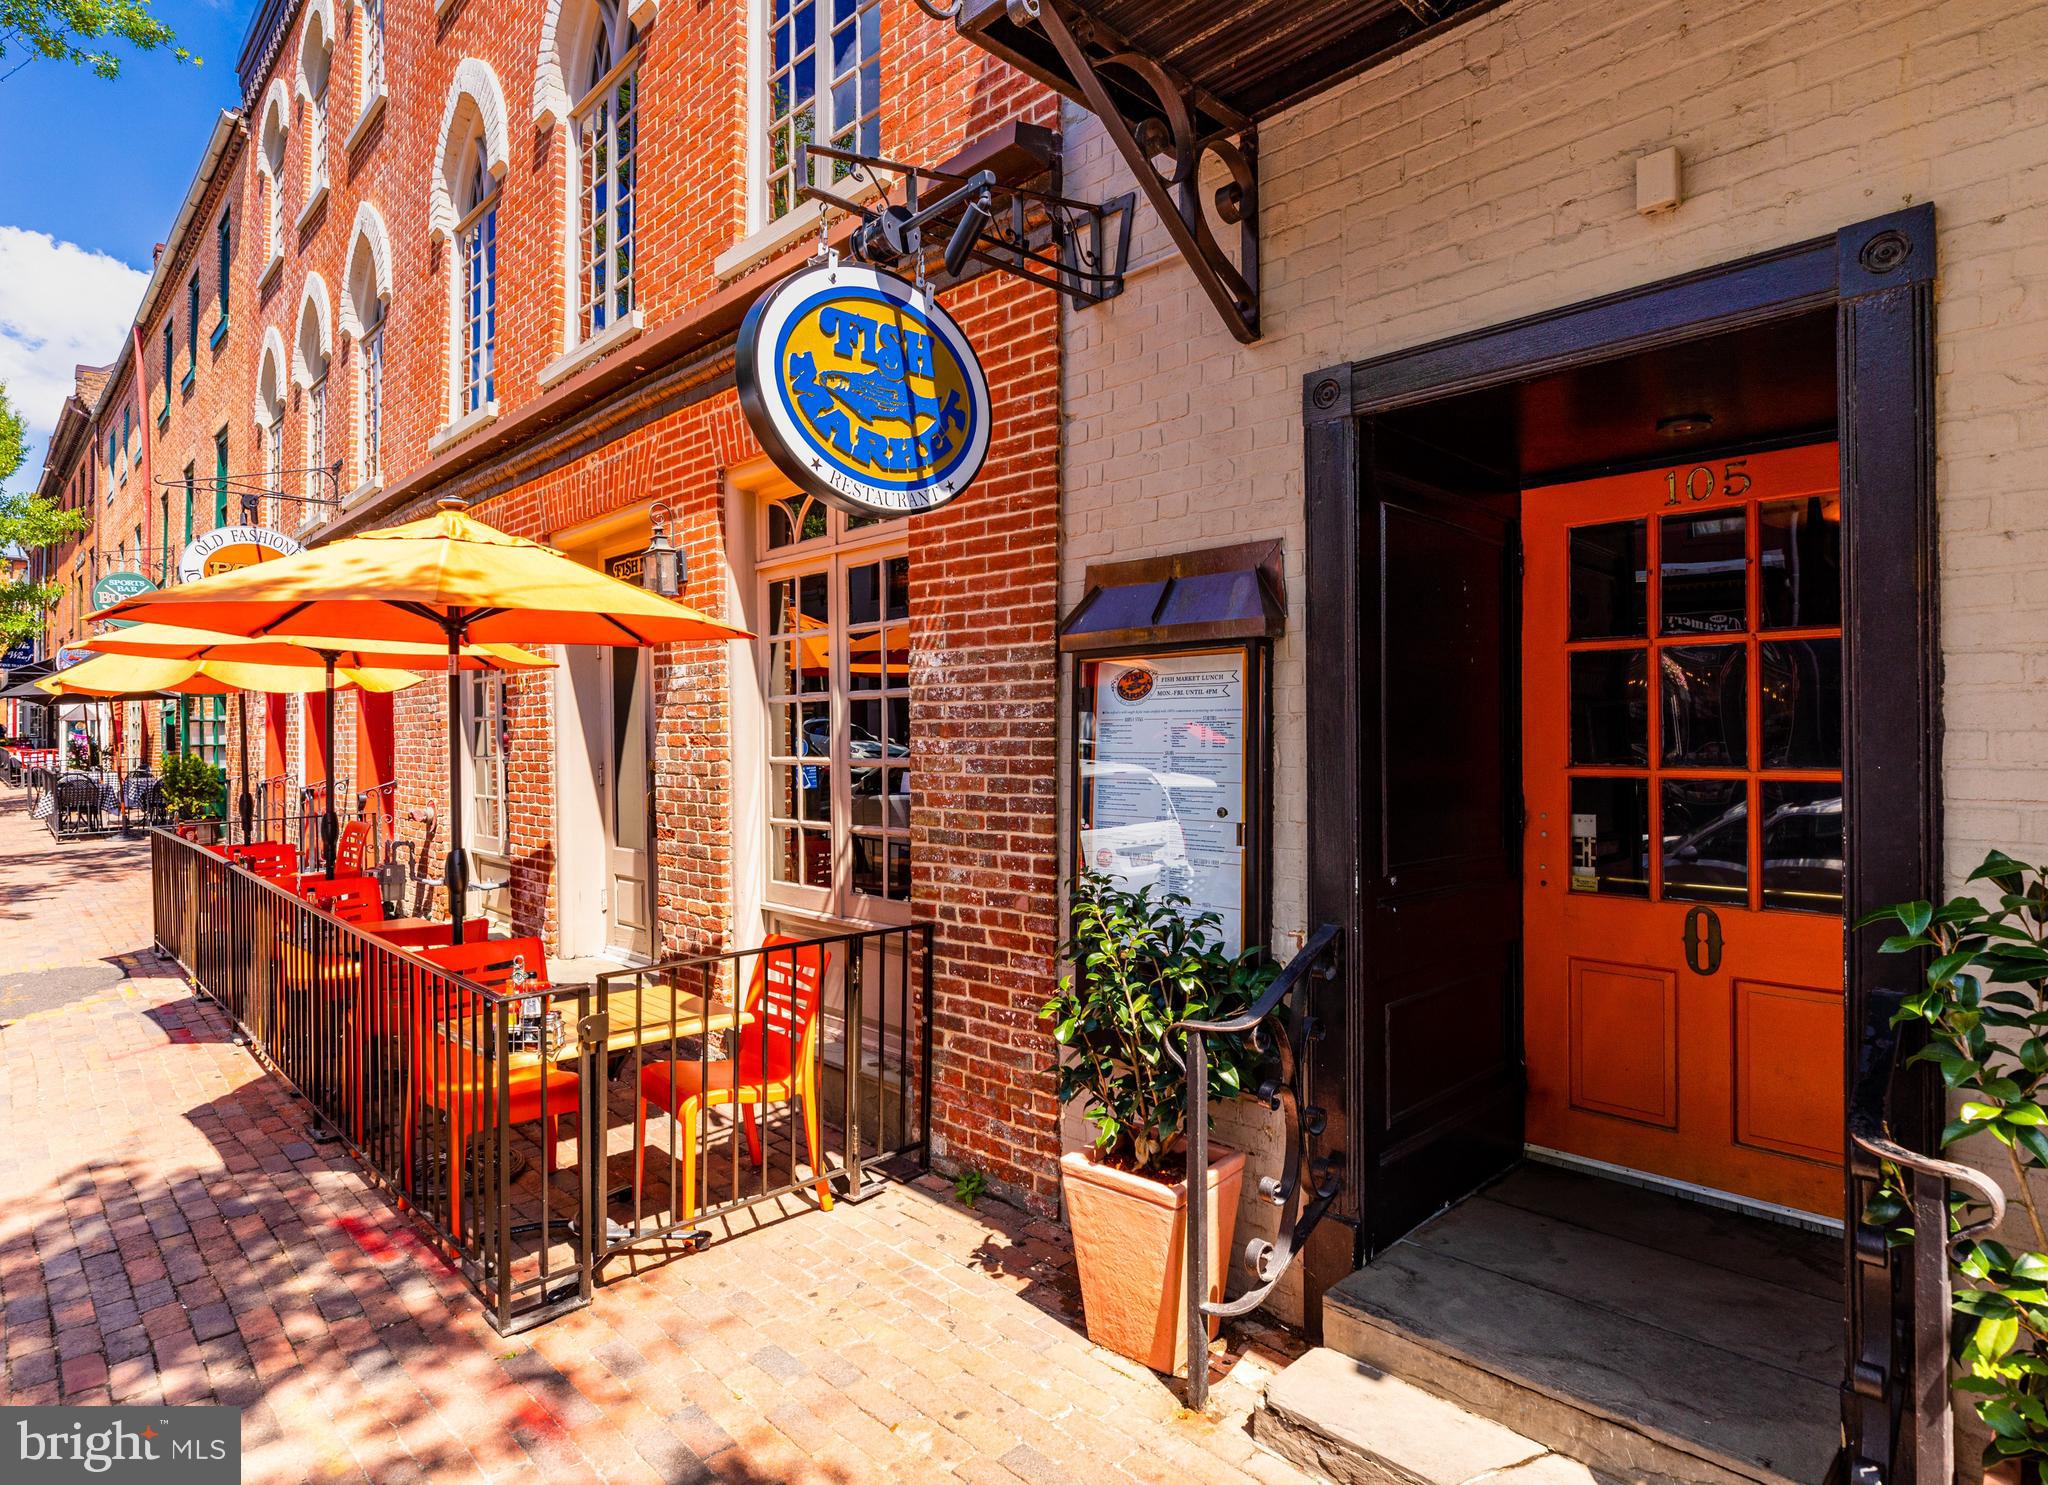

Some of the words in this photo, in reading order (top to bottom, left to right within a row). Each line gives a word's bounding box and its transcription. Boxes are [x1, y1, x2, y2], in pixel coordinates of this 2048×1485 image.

[819, 306, 935, 381] FISH
[789, 351, 966, 470] MARKET
[829, 469, 940, 506] RESTAURANT
[1664, 460, 1752, 506] 105
[194, 534, 224, 556] OLD
[613, 558, 639, 579] FISH
[108, 579, 146, 587] SPORTS
[117, 585, 138, 593] BAR
[7, 650, 34, 662] Wharf
[1176, 674, 1200, 682] MARKET
